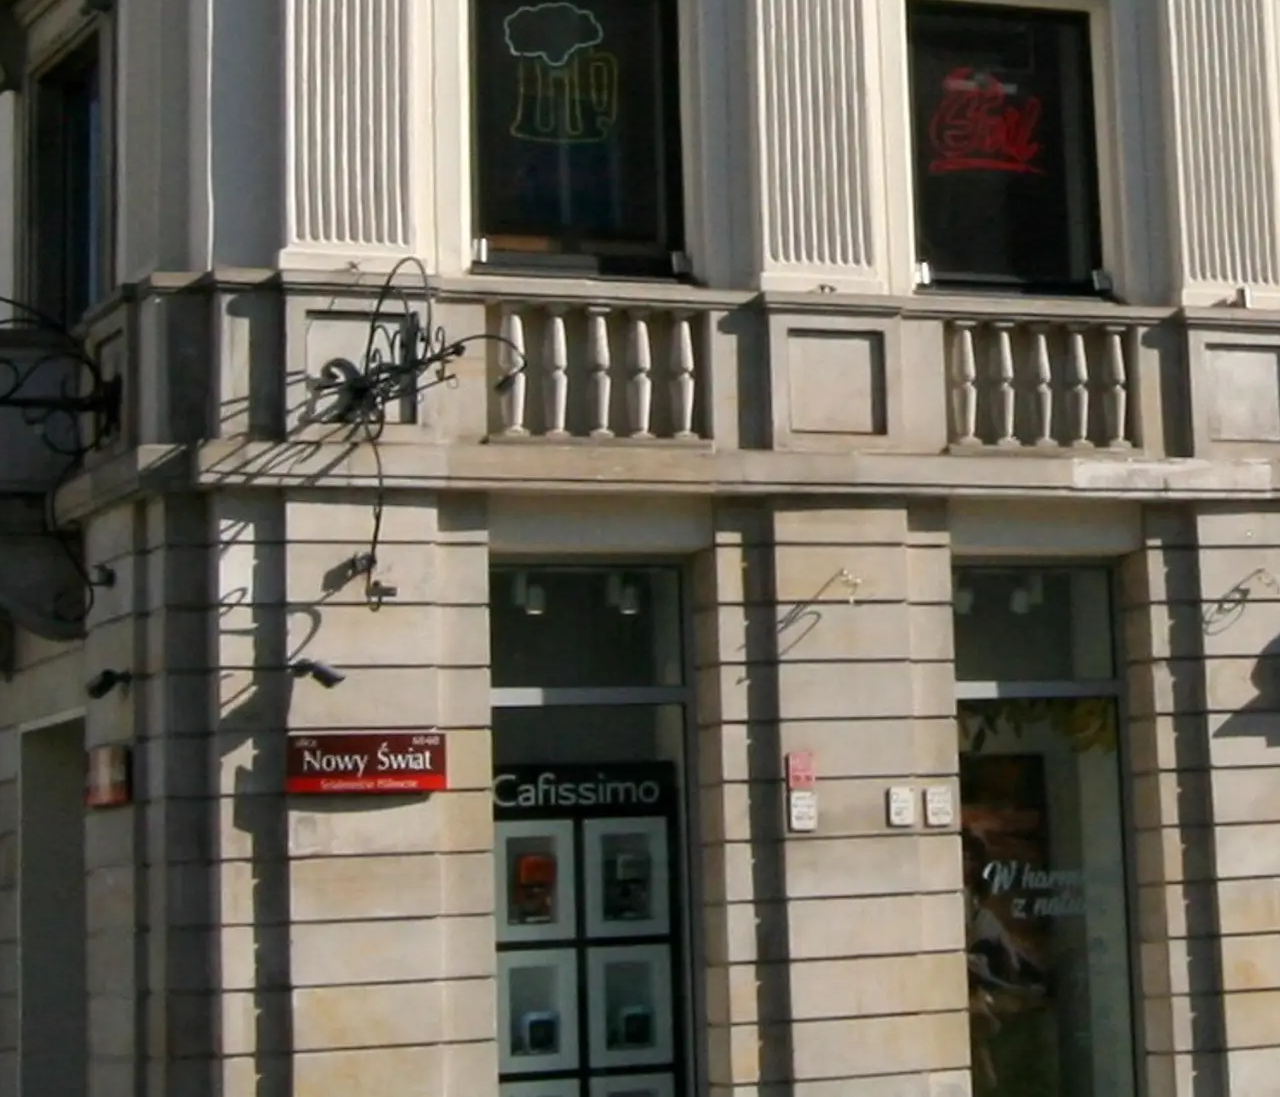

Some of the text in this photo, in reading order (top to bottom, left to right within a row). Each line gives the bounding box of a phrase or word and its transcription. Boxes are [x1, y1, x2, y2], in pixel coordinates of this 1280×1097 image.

[302, 741, 433, 778] Nowy Świat
[493, 771, 661, 808] Cafissimo
